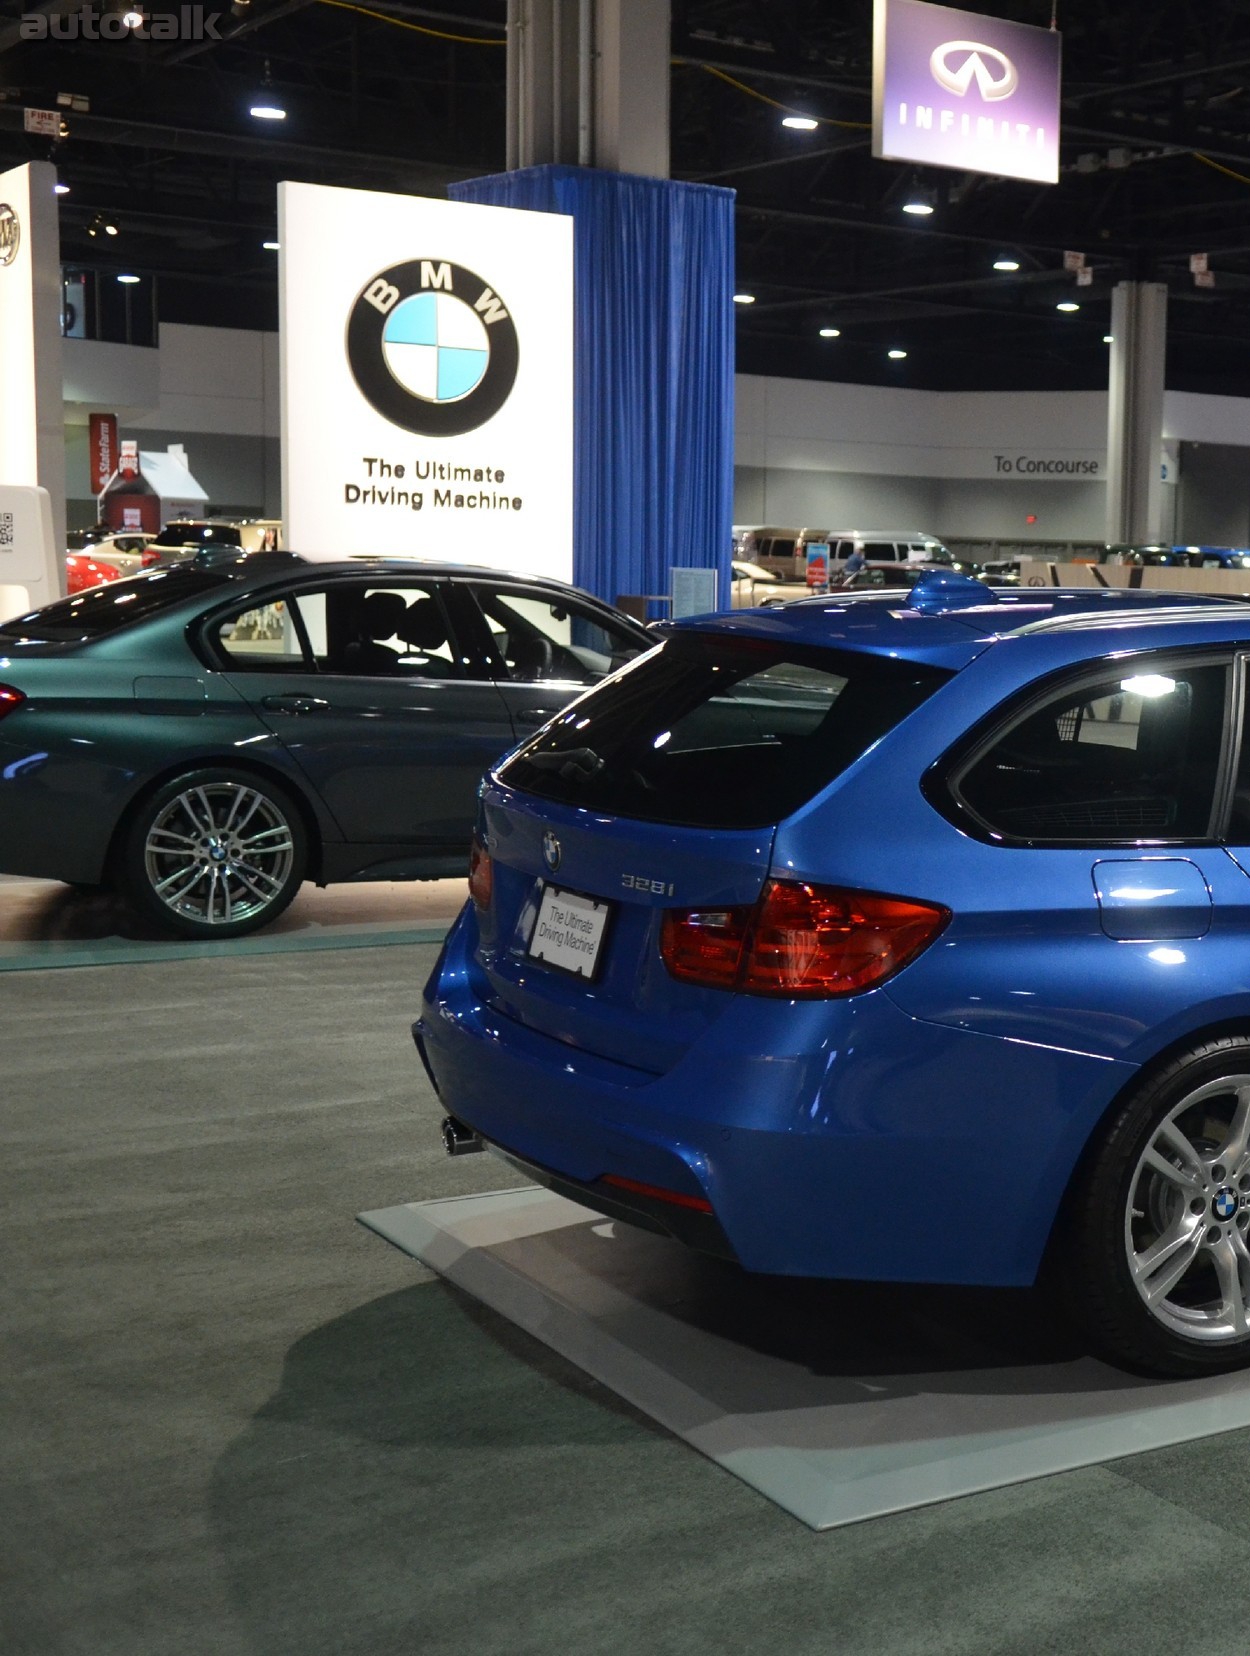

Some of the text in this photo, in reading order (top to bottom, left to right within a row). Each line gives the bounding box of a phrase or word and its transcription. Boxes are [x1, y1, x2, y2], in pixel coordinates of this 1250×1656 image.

[31, 110, 54, 120] FIRE
[900, 102, 1045, 148] INFINITI
[363, 261, 508, 325] BMW
[363, 457, 505, 483] The Ultimate
[994, 456, 1098, 473] To Concourse
[344, 484, 523, 511] Driving Machine
[621, 873, 674, 897] 328i
[551, 905, 593, 935] The Ultimate
[538, 922, 596, 955] Driving Machine
